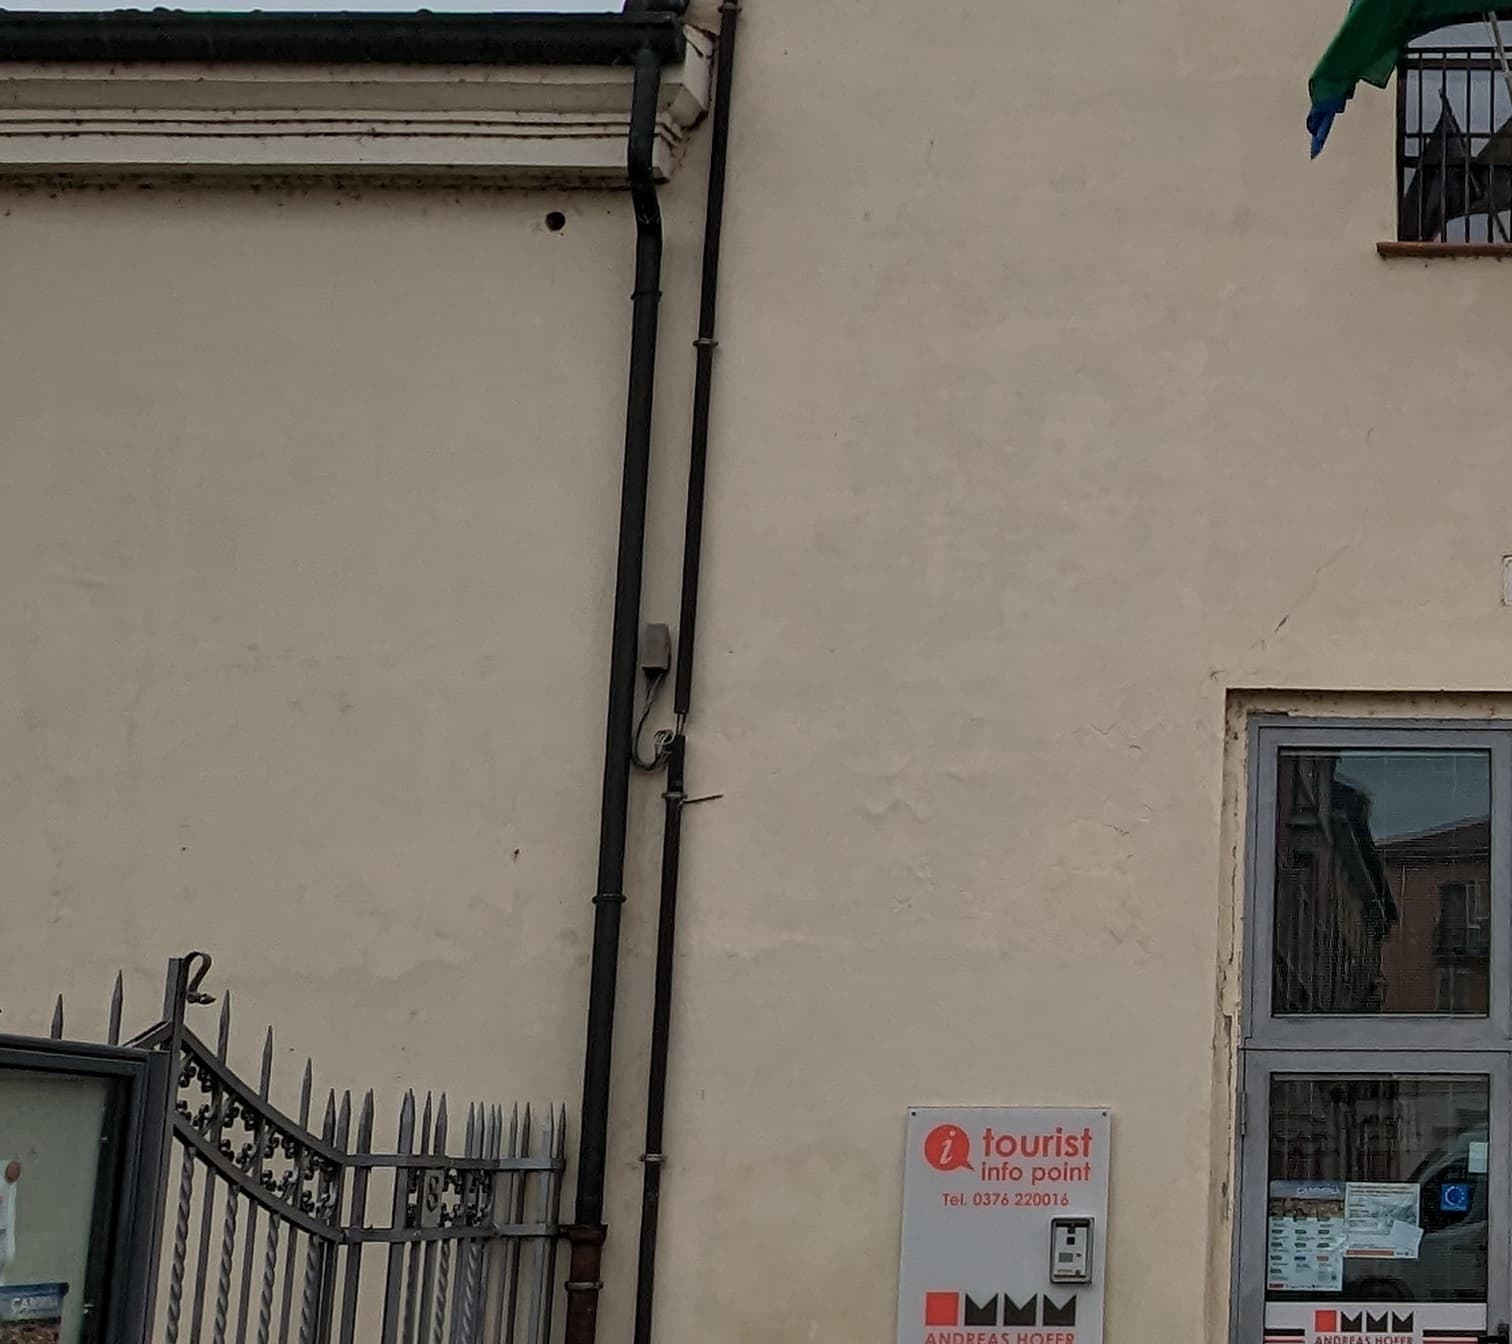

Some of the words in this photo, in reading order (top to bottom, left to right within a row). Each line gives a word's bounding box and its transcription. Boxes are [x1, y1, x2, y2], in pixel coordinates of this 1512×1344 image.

[983, 1127, 1092, 1157] tourist
[981, 1162, 1023, 1181] info
[1031, 1162, 1091, 1185] point
[943, 1193, 966, 1207] Tel.
[973, 1193, 1009, 1206] 0376
[1015, 1193, 1069, 1206] 220016
